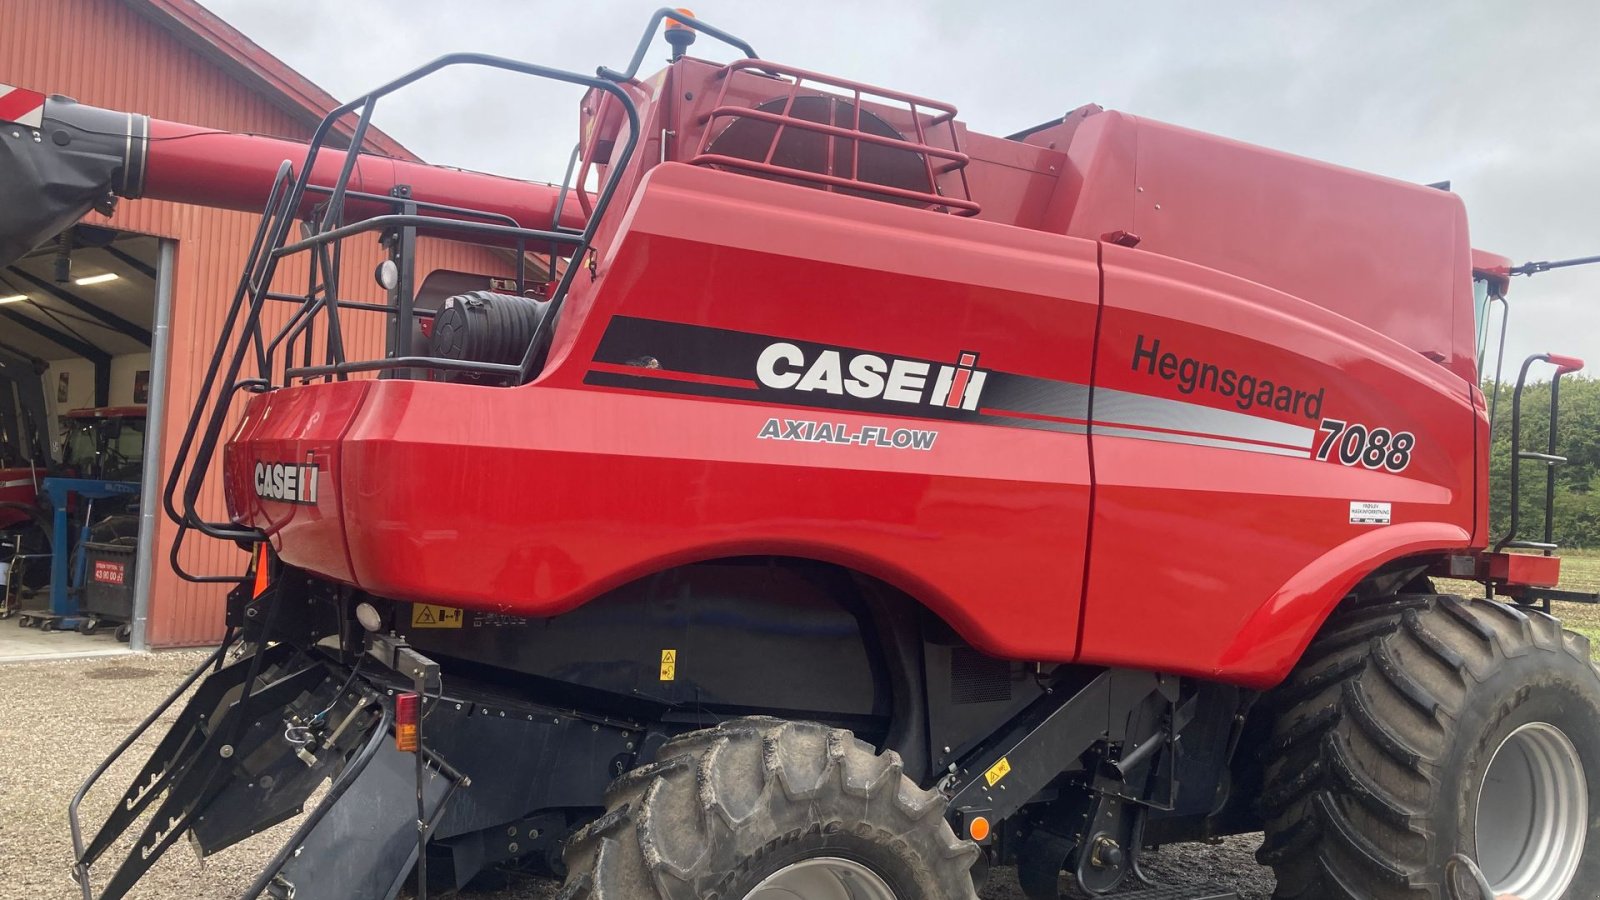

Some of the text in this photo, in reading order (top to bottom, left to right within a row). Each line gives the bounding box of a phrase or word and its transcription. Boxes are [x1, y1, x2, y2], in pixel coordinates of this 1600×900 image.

[756, 342, 931, 404] CASE
[1131, 334, 1324, 420] Hegnsgaard
[757, 418, 938, 451] AXIAL-FLOW
[1315, 417, 1416, 473] 7088
[254, 462, 297, 501] CASE
